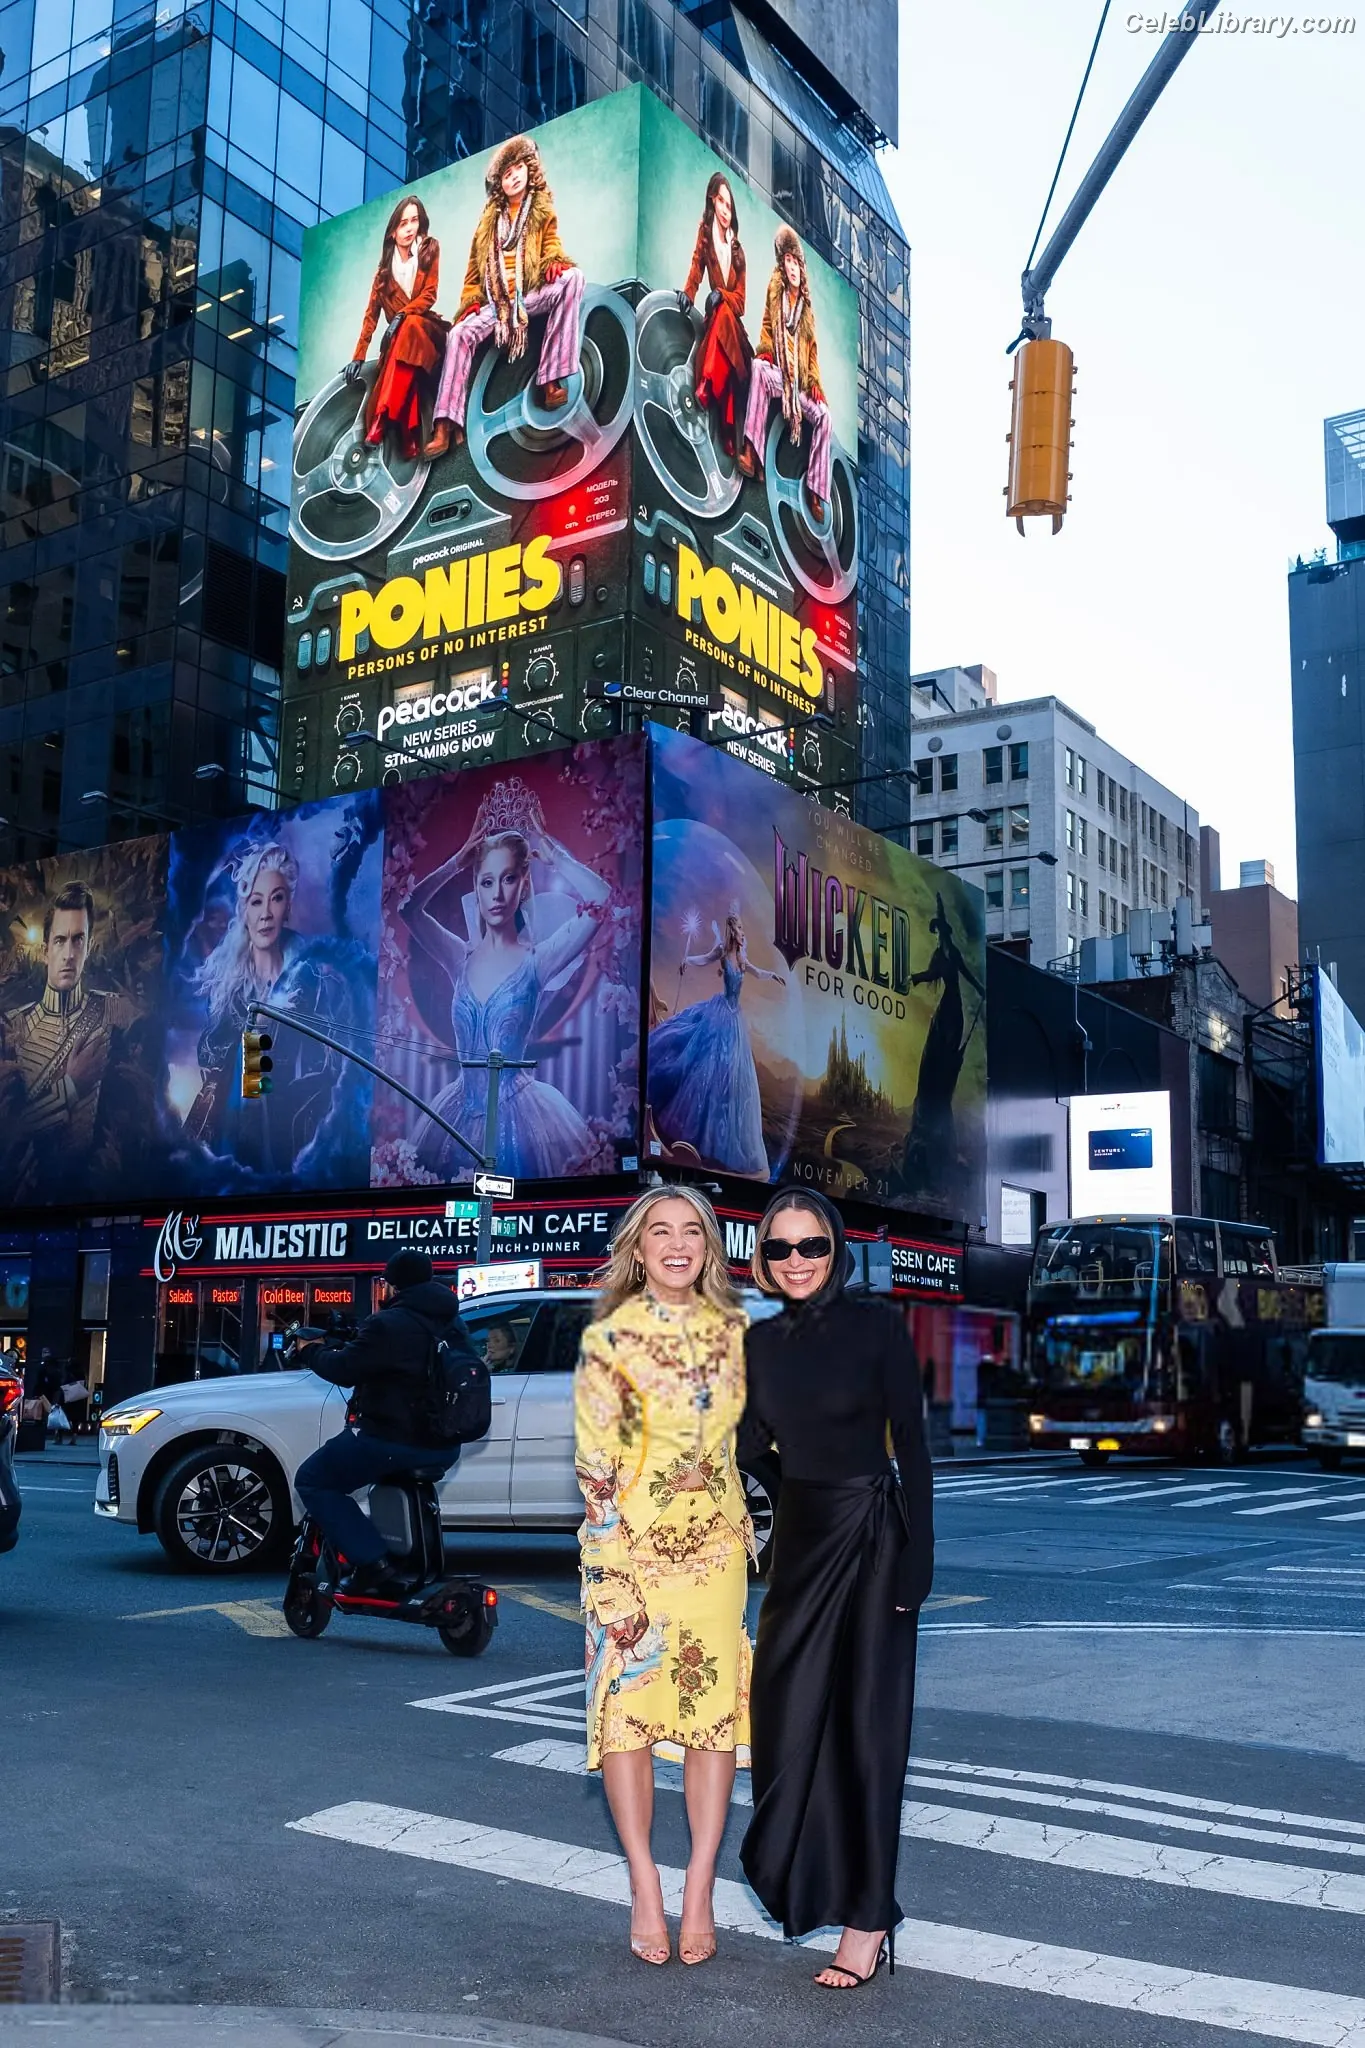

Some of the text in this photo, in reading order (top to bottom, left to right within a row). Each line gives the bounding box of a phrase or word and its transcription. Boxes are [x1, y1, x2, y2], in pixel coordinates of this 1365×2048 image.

[586, 480, 618, 493] МОДЕЛЬ
[594, 495, 610, 505] 203
[585, 508, 617, 522] СТЕРЕО
[413, 538, 485, 569] peacock ORIGINAL
[338, 535, 561, 662] PONIES
[677, 543, 824, 698] PONIES
[348, 616, 548, 680] PERSONS OF NO INTEREST
[685, 628, 816, 716] PERSONS OF NO INTEREST
[377, 672, 498, 742] peacock
[623, 685, 709, 706] Clear Channel
[403, 719, 477, 748] NEW SERIES
[384, 731, 495, 768] STREAMING NOW
[726, 741, 776, 775] NEW SERIES
[808, 809, 830, 830] YOU
[836, 823, 861, 846] WILL
[816, 833, 872, 872] CHANGED
[773, 824, 912, 997] WICKED
[805, 965, 907, 1021] FOR GOOD
[793, 1162, 889, 1196] NOVEMBER 21
[214, 1222, 348, 1261] MAJESTIC
[367, 1213, 534, 1241] DELICATESN
[545, 1212, 609, 1235] CAFE
[532, 1241, 580, 1252] DINNER
[927, 1254, 956, 1275] CAFE
[169, 1289, 194, 1303] Salads
[212, 1289, 238, 1303] Pastas
[314, 1288, 352, 1303] Desserts
[895, 1273, 916, 1284] LUNCH
[920, 1276, 943, 1288] DINNER
[264, 1289, 304, 1305] Cold Beer
